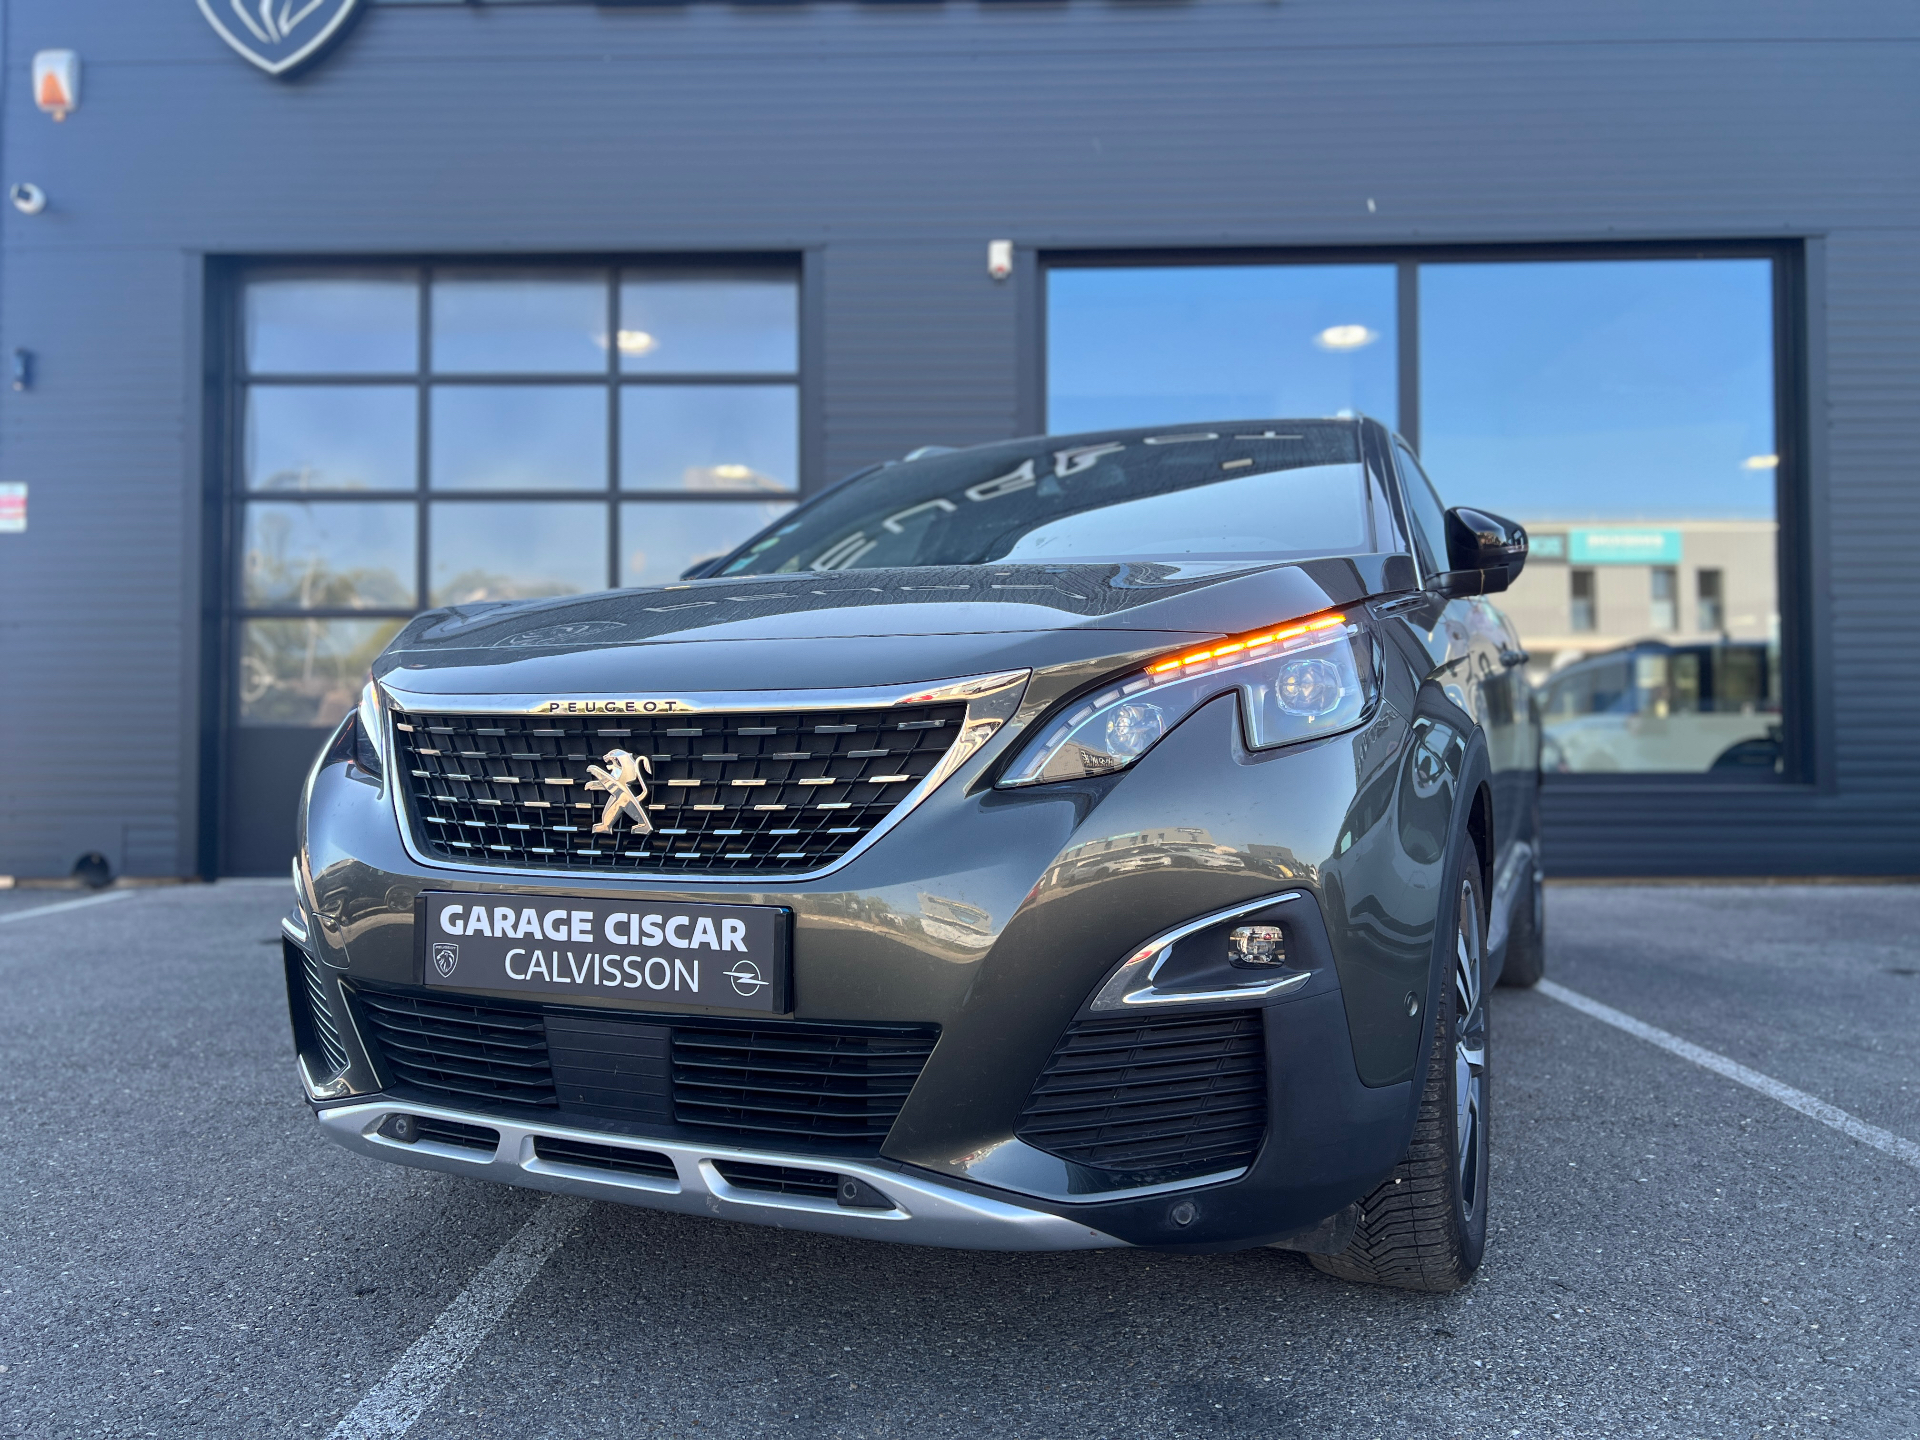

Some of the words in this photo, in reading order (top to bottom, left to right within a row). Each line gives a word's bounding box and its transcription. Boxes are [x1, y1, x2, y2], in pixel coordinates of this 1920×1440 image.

[549, 701, 677, 713] PEUGEOT
[440, 904, 594, 943] GARAGE
[604, 912, 749, 952] CISCAR
[504, 948, 699, 993] CALVISSON
